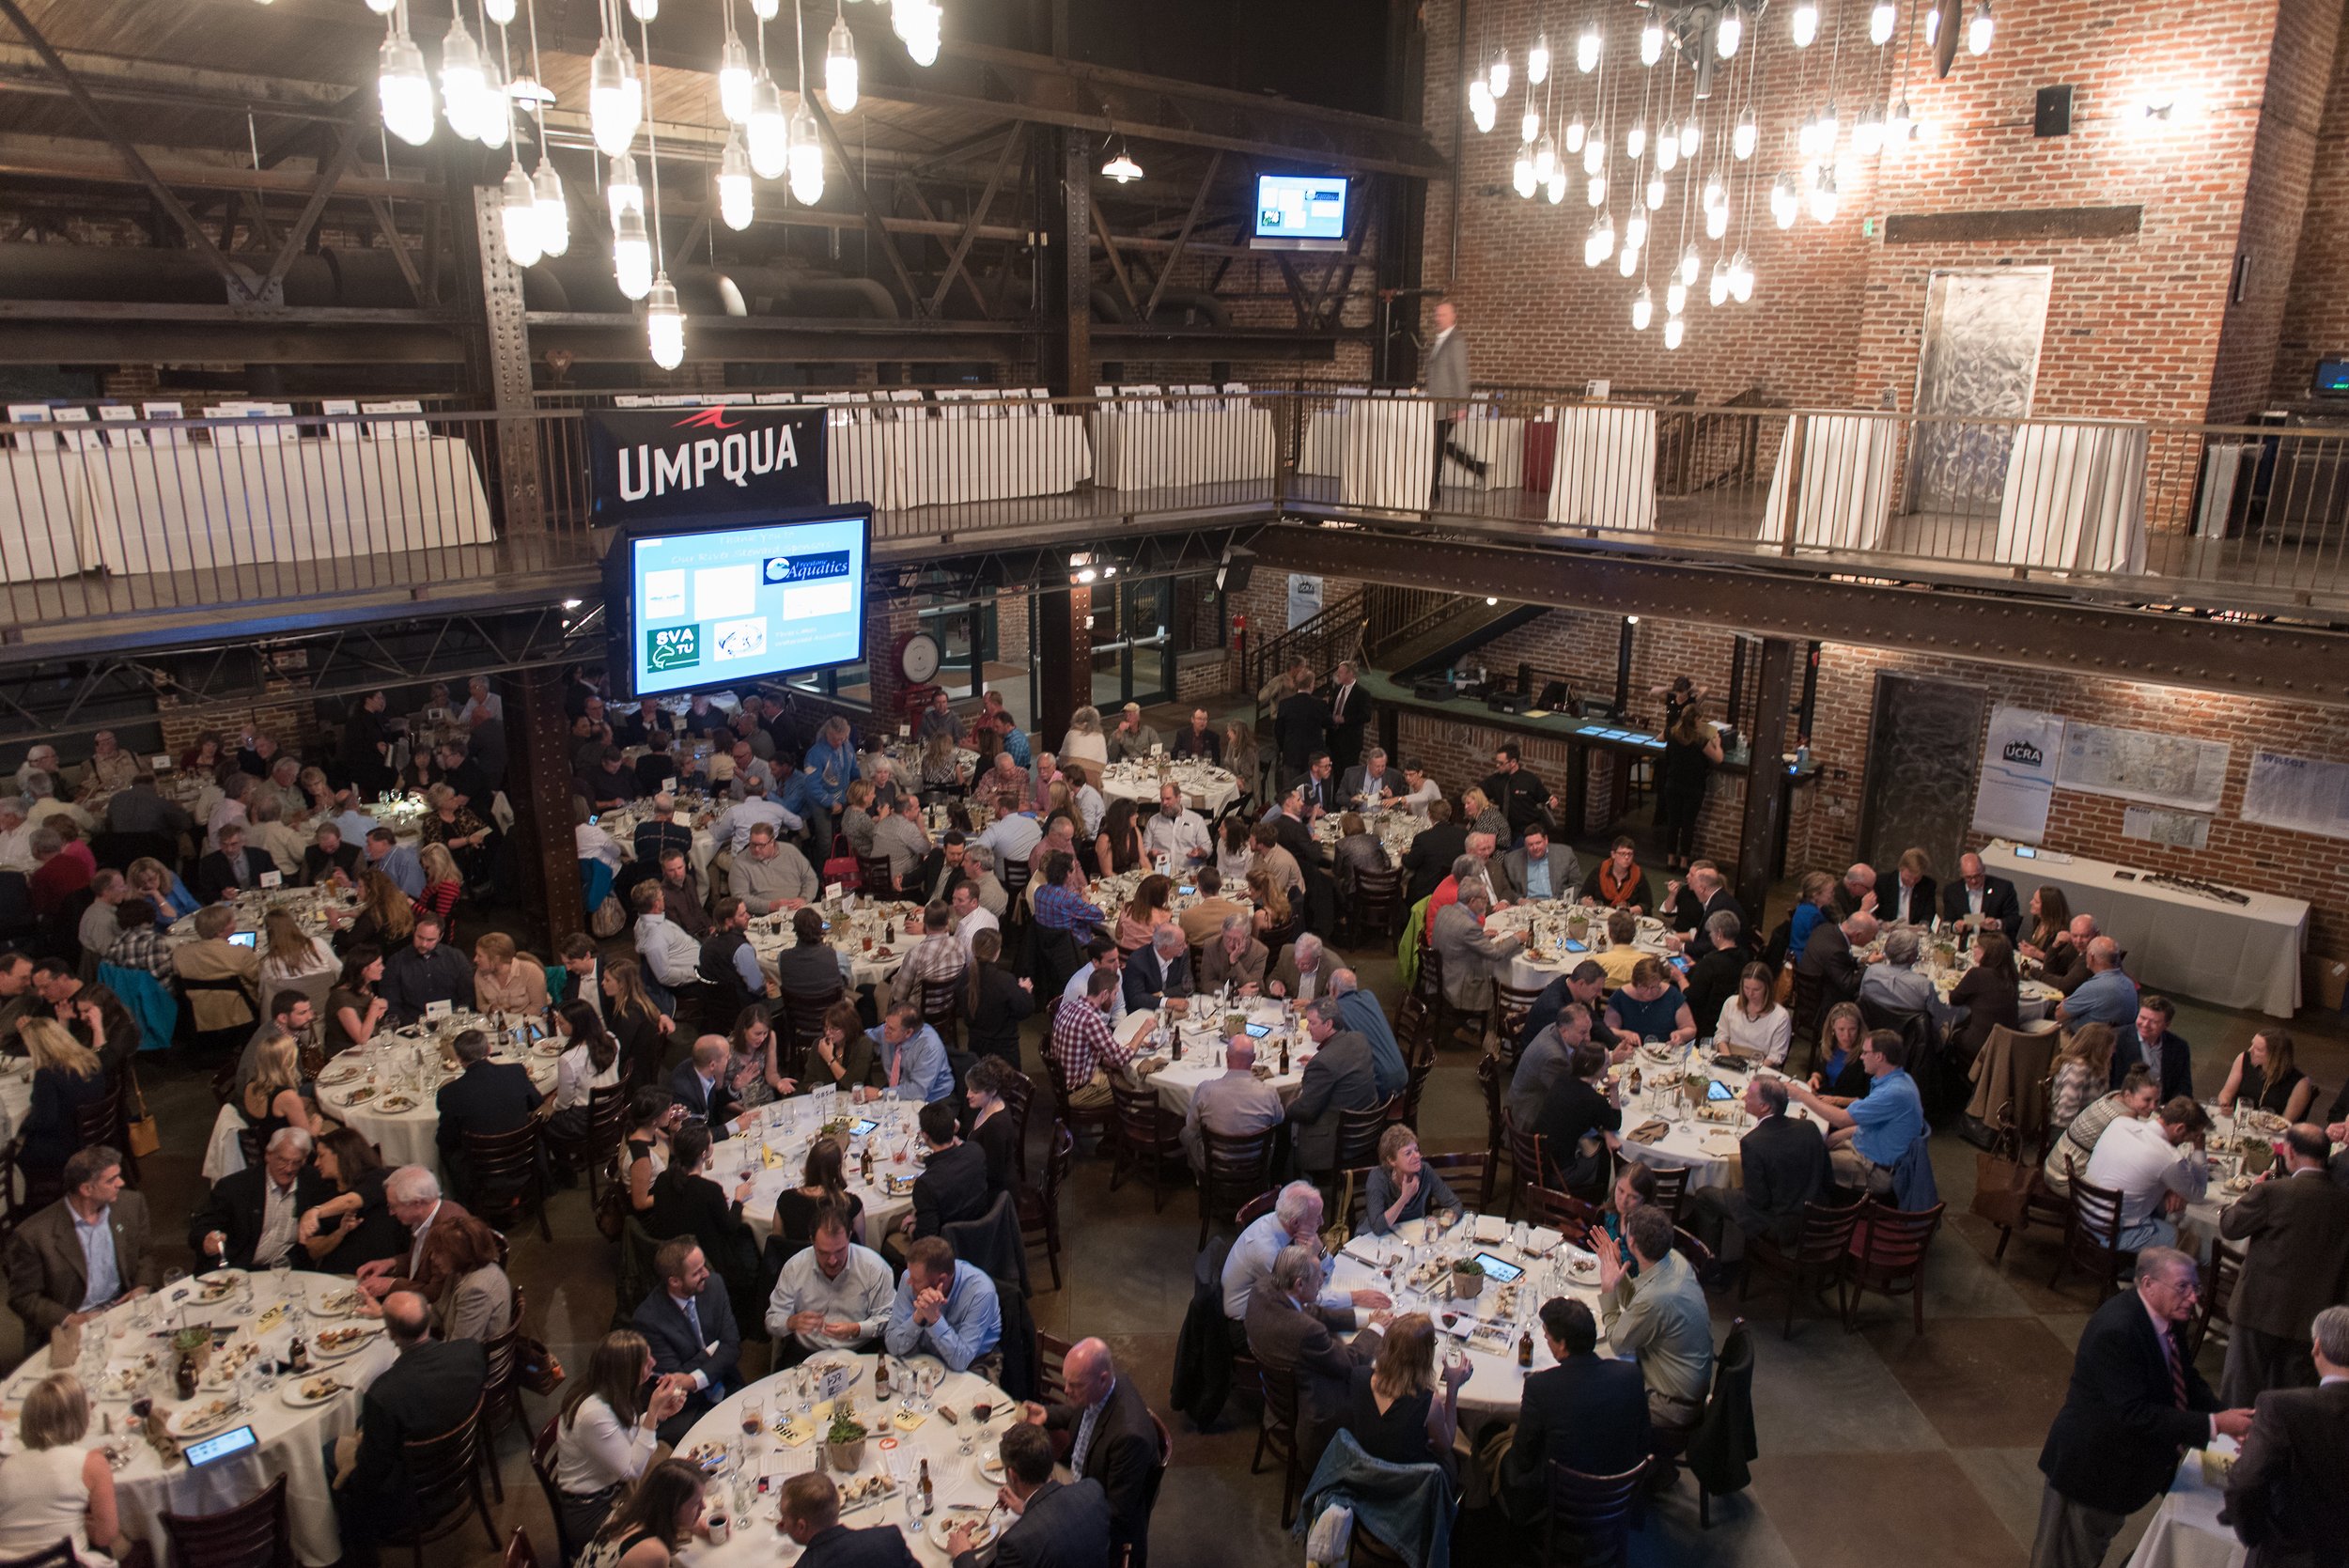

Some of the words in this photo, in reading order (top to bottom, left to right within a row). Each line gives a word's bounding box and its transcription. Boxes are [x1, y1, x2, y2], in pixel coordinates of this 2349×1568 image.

[618, 424, 799, 502] UMPQUA
[786, 560, 848, 581] Aquatics
[656, 628, 694, 645] SVA
[677, 644, 693, 655] TU
[2005, 745, 2041, 762] UCRA
[2262, 753, 2308, 768] Water
[815, 1089, 835, 1099] GBSM
[772, 1423, 799, 1441] 386
